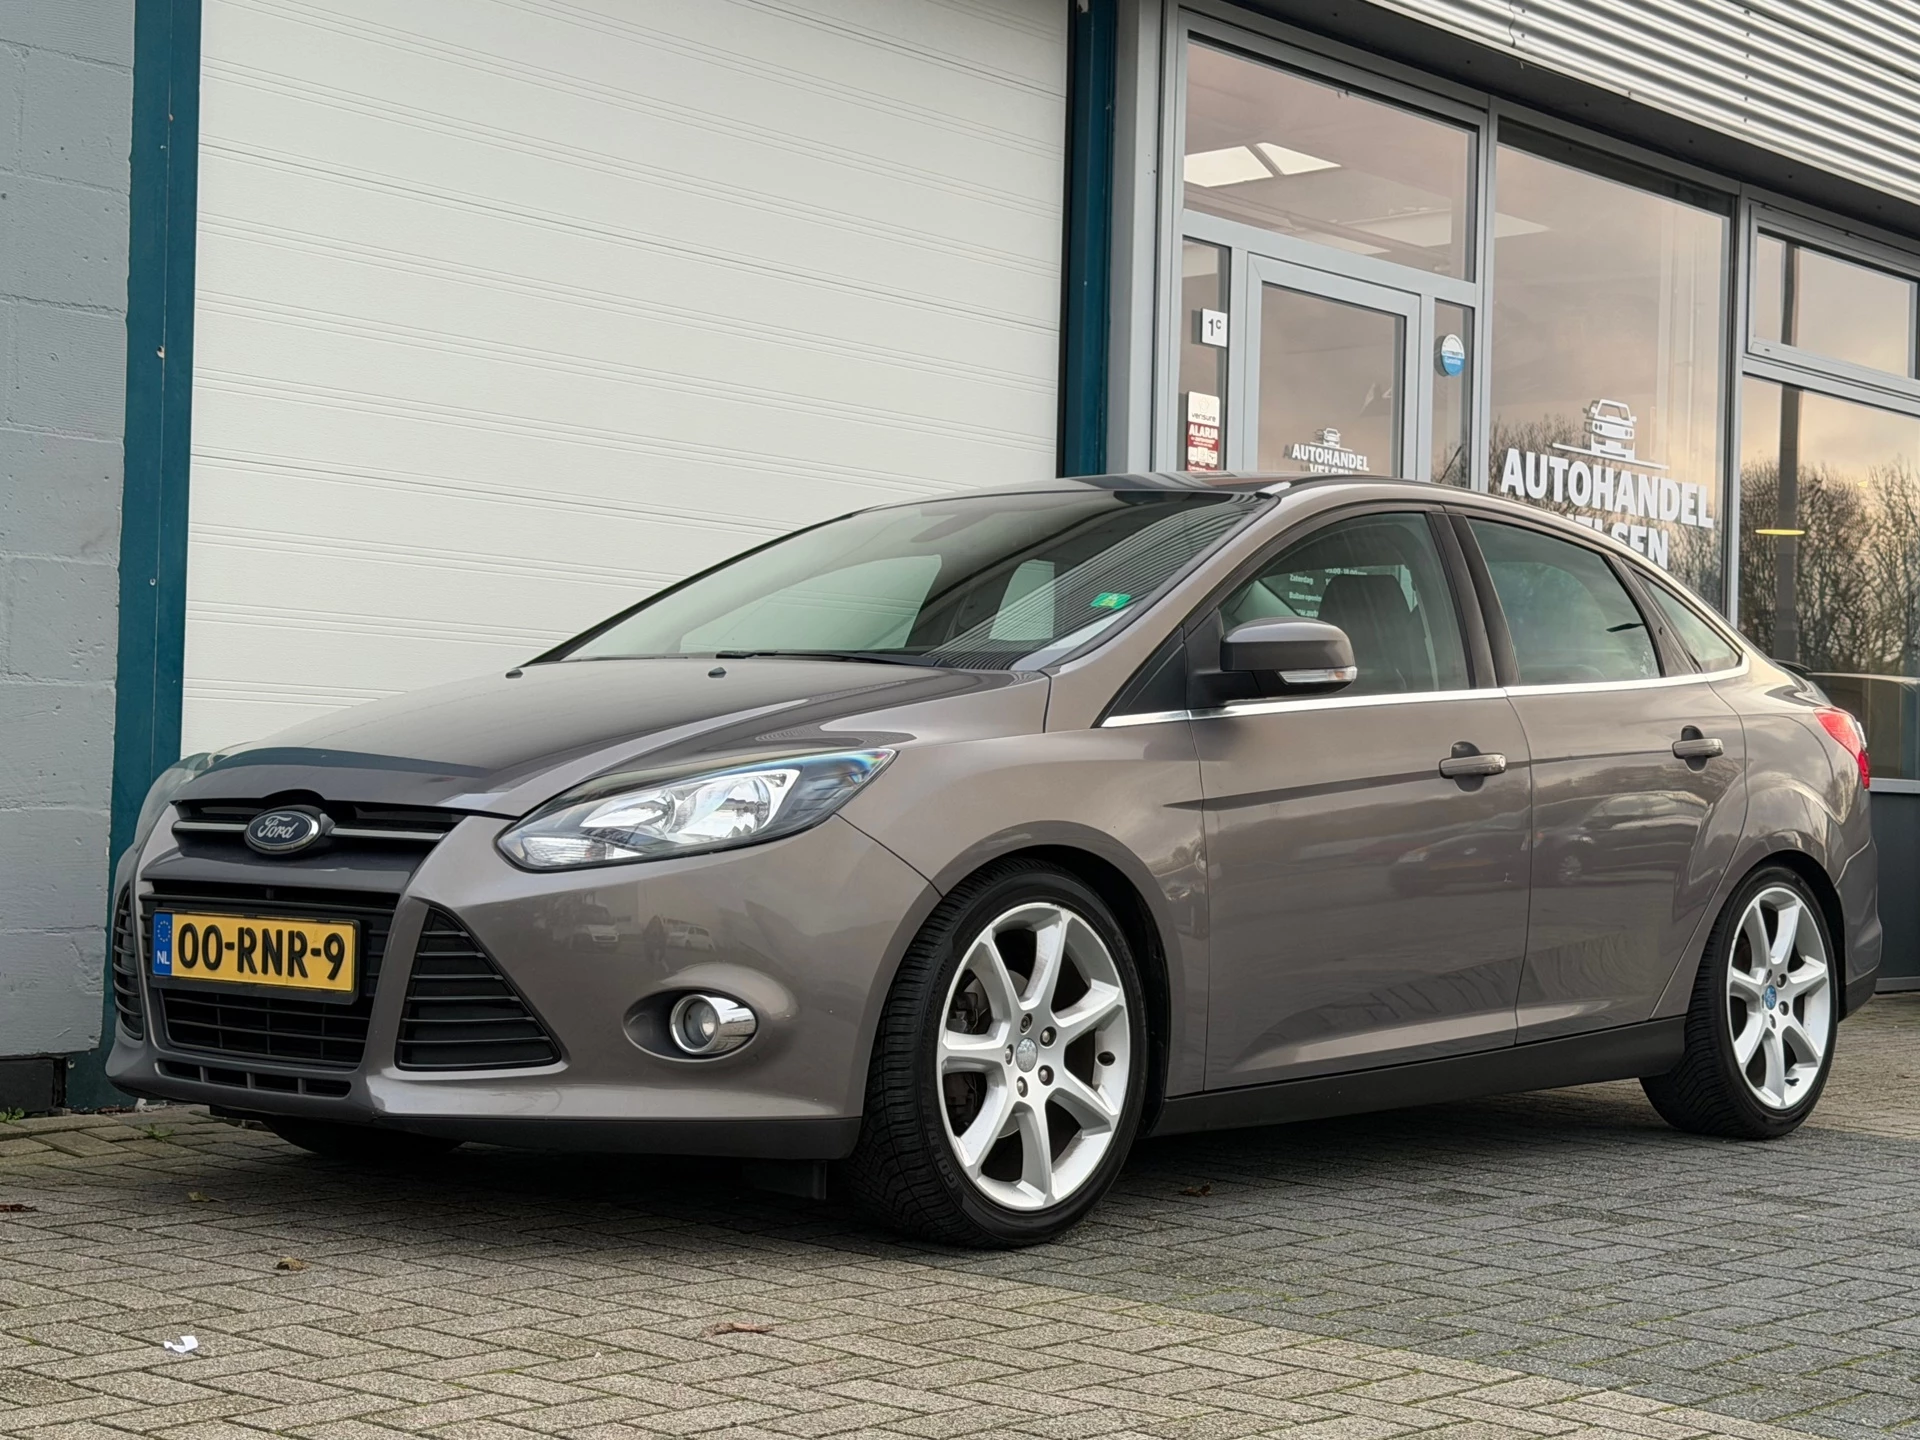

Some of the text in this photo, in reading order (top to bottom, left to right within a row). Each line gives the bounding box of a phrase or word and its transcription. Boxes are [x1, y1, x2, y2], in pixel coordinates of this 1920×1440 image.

[1189, 424, 1218, 440] ALARM
[1291, 443, 1370, 472] AUTOHANDEL
[1500, 447, 1714, 529] AUTOHANDEL
[257, 815, 299, 839] Ford
[156, 950, 170, 966] NL
[177, 922, 345, 981] 00-RNR-9
